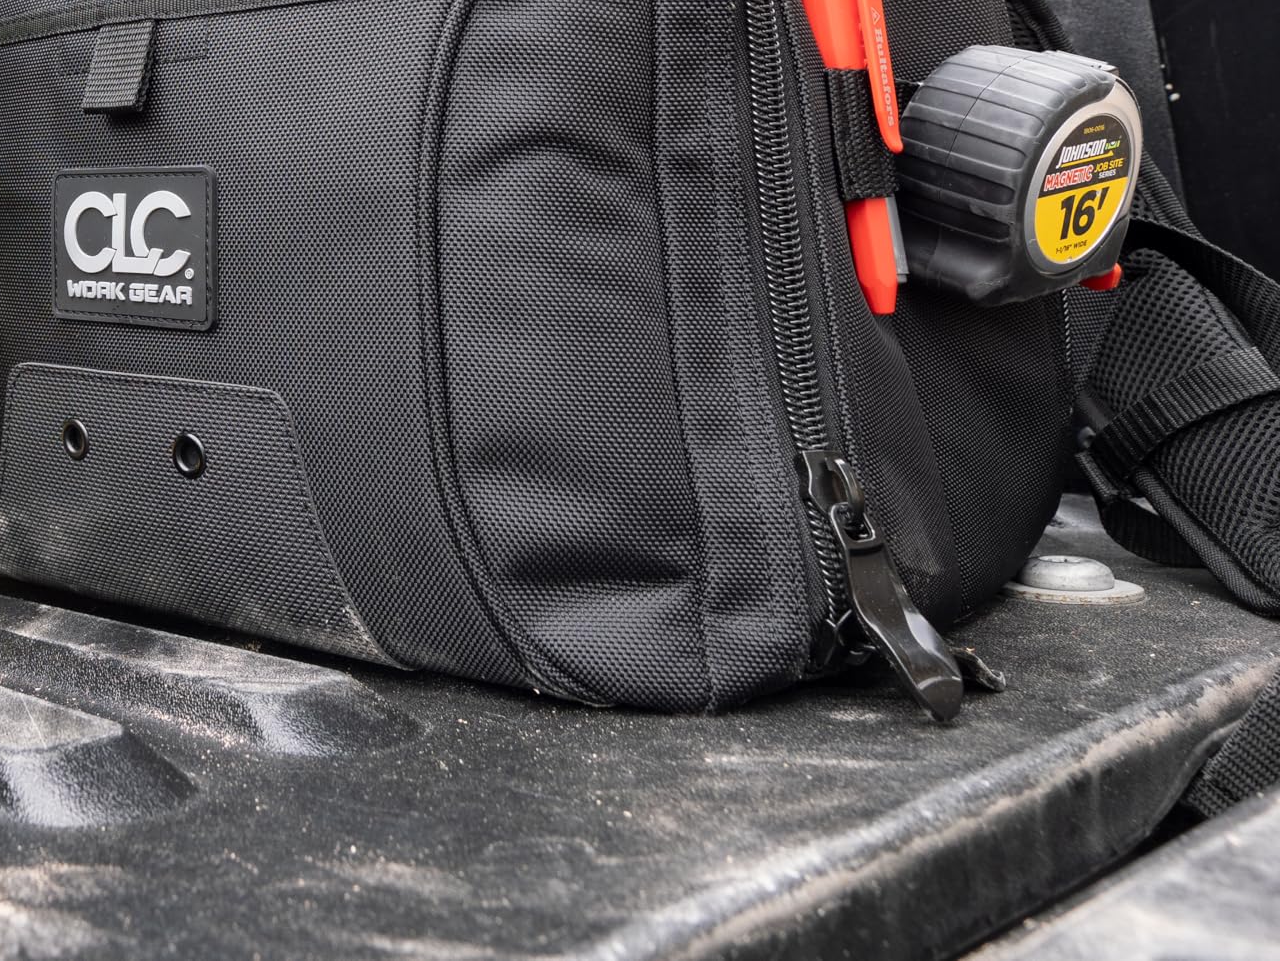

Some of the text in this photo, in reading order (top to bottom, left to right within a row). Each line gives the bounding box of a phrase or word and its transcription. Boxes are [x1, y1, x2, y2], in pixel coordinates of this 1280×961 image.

[875, 28, 895, 127] Hultafors
[1043, 158, 1124, 192] MAGNETIC JOB SITE
[1098, 169, 1117, 179] SERIES
[64, 191, 192, 276] CLC
[1073, 239, 1088, 249] WIDE
[67, 279, 193, 305] WORK GEAR
